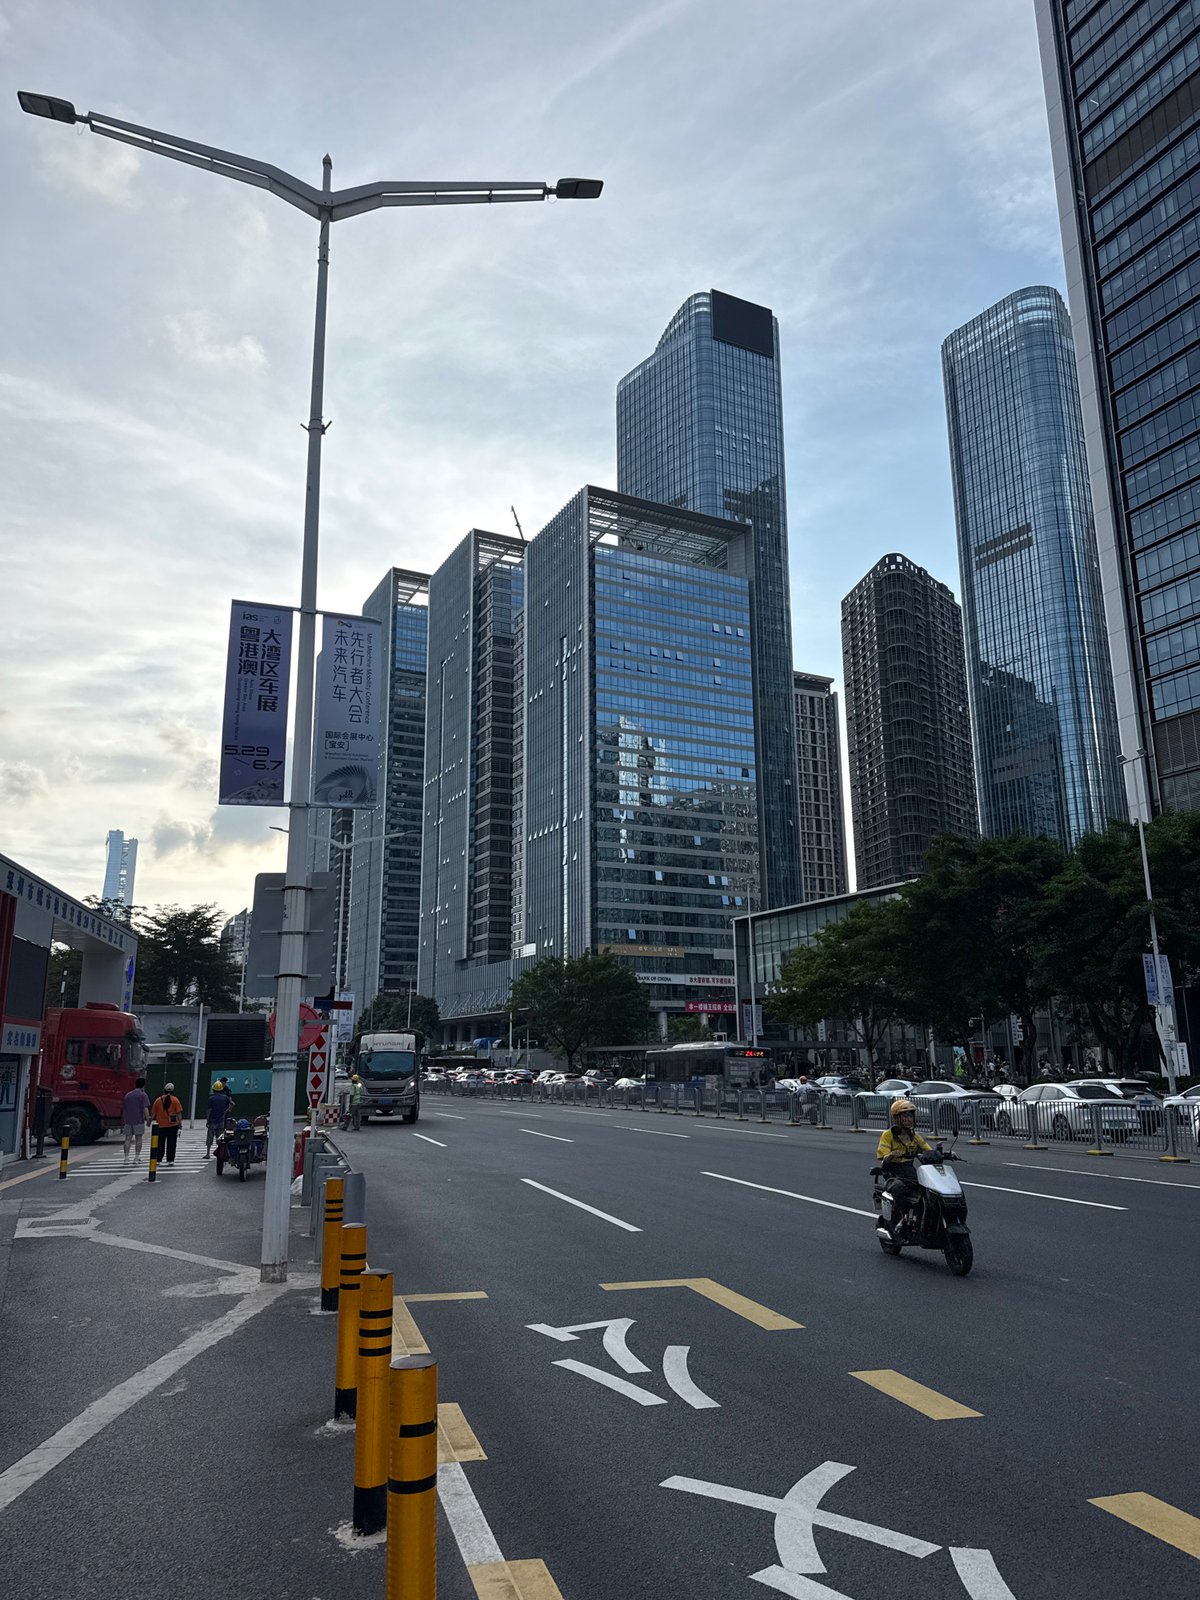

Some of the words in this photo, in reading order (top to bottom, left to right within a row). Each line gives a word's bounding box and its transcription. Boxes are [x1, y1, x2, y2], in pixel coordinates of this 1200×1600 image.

[242, 611, 258, 622] ias
[237, 625, 260, 676] 粤港澳
[332, 629, 349, 703] 未来汽车
[257, 628, 282, 713] 大湾区车展
[348, 631, 365, 723] 先行者大会
[364, 691, 372, 725] Conference
[223, 744, 270, 757] 5.29
[325, 730, 374, 742] 国际会展中心
[252, 759, 283, 771] 6.7
